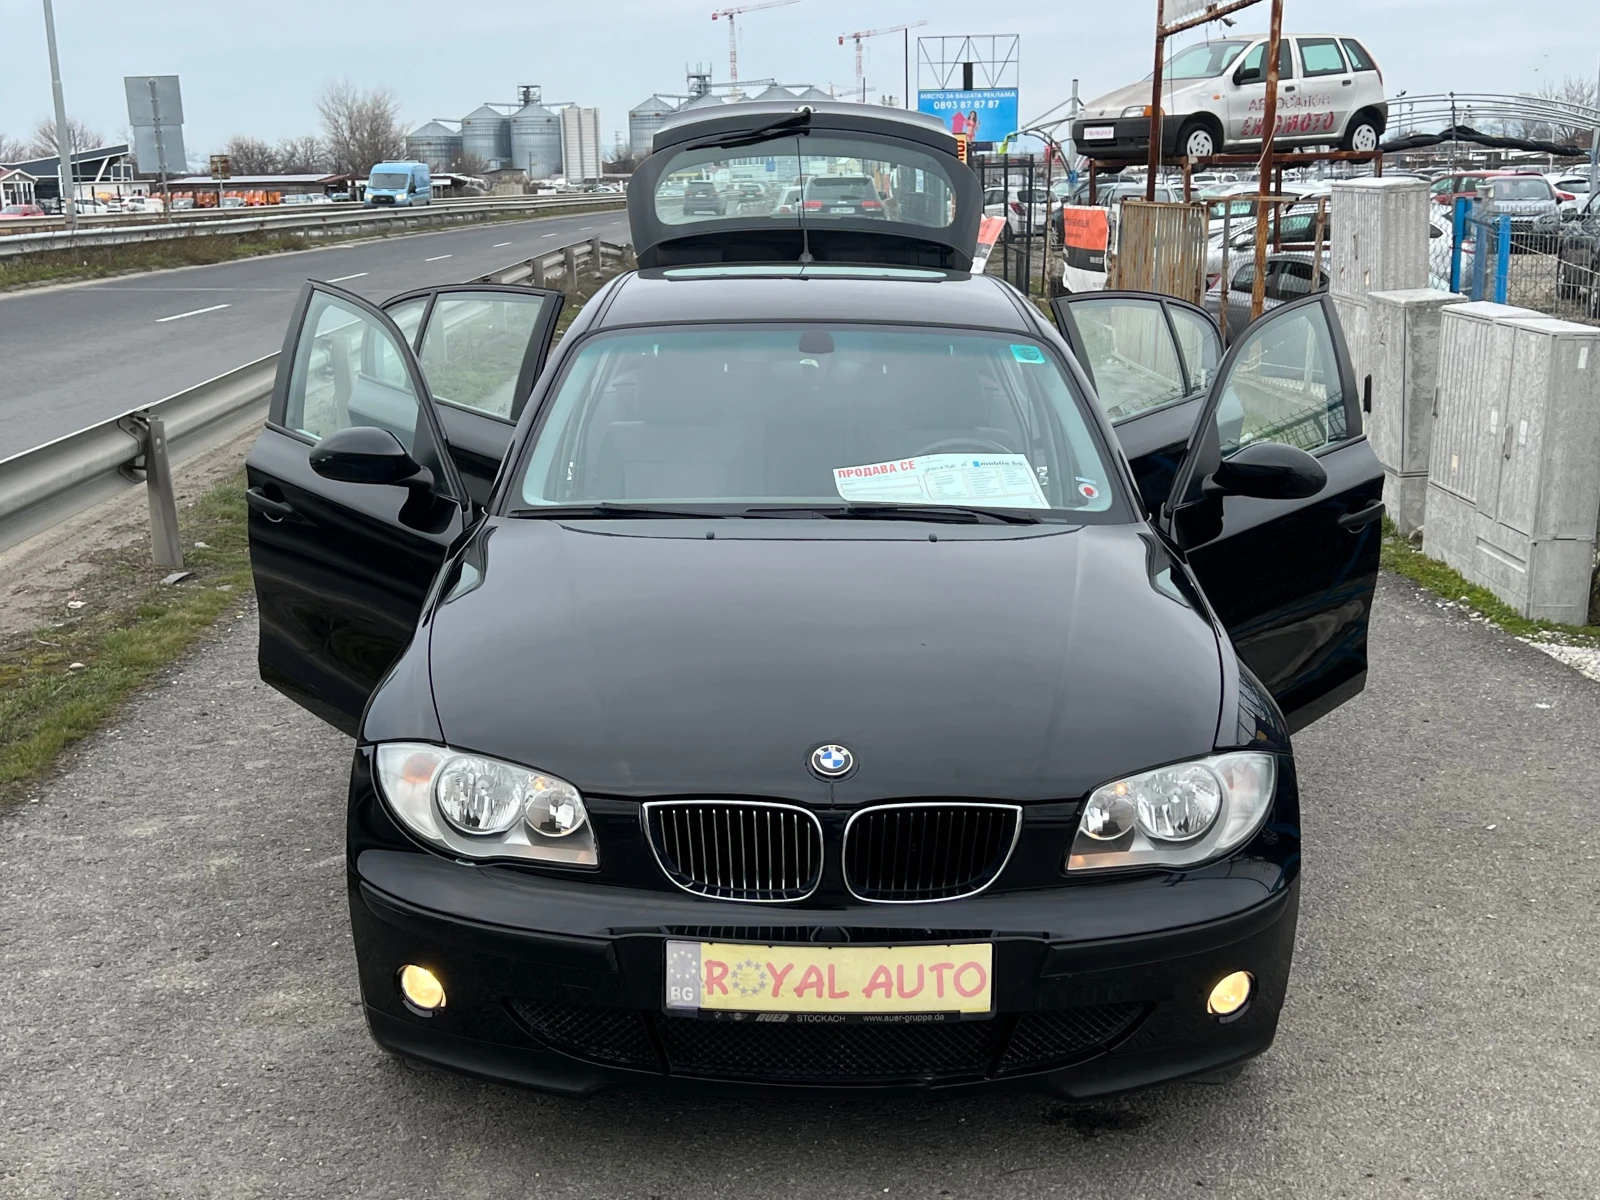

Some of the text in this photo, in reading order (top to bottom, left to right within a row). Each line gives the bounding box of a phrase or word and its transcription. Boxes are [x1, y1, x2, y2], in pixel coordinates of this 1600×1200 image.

[933, 100, 1000, 110] 0893 87 87 87
[1248, 93, 1330, 111] АВОСАЛОН
[838, 463, 897, 478] ПРОДАВА
[900, 460, 917, 471] СЕ
[703, 959, 987, 999] ROYAL AUTO
[670, 986, 694, 1001] BG
[796, 1014, 846, 1023] STOCKACH
[862, 1013, 945, 1024] www.auer-gruppe.de
